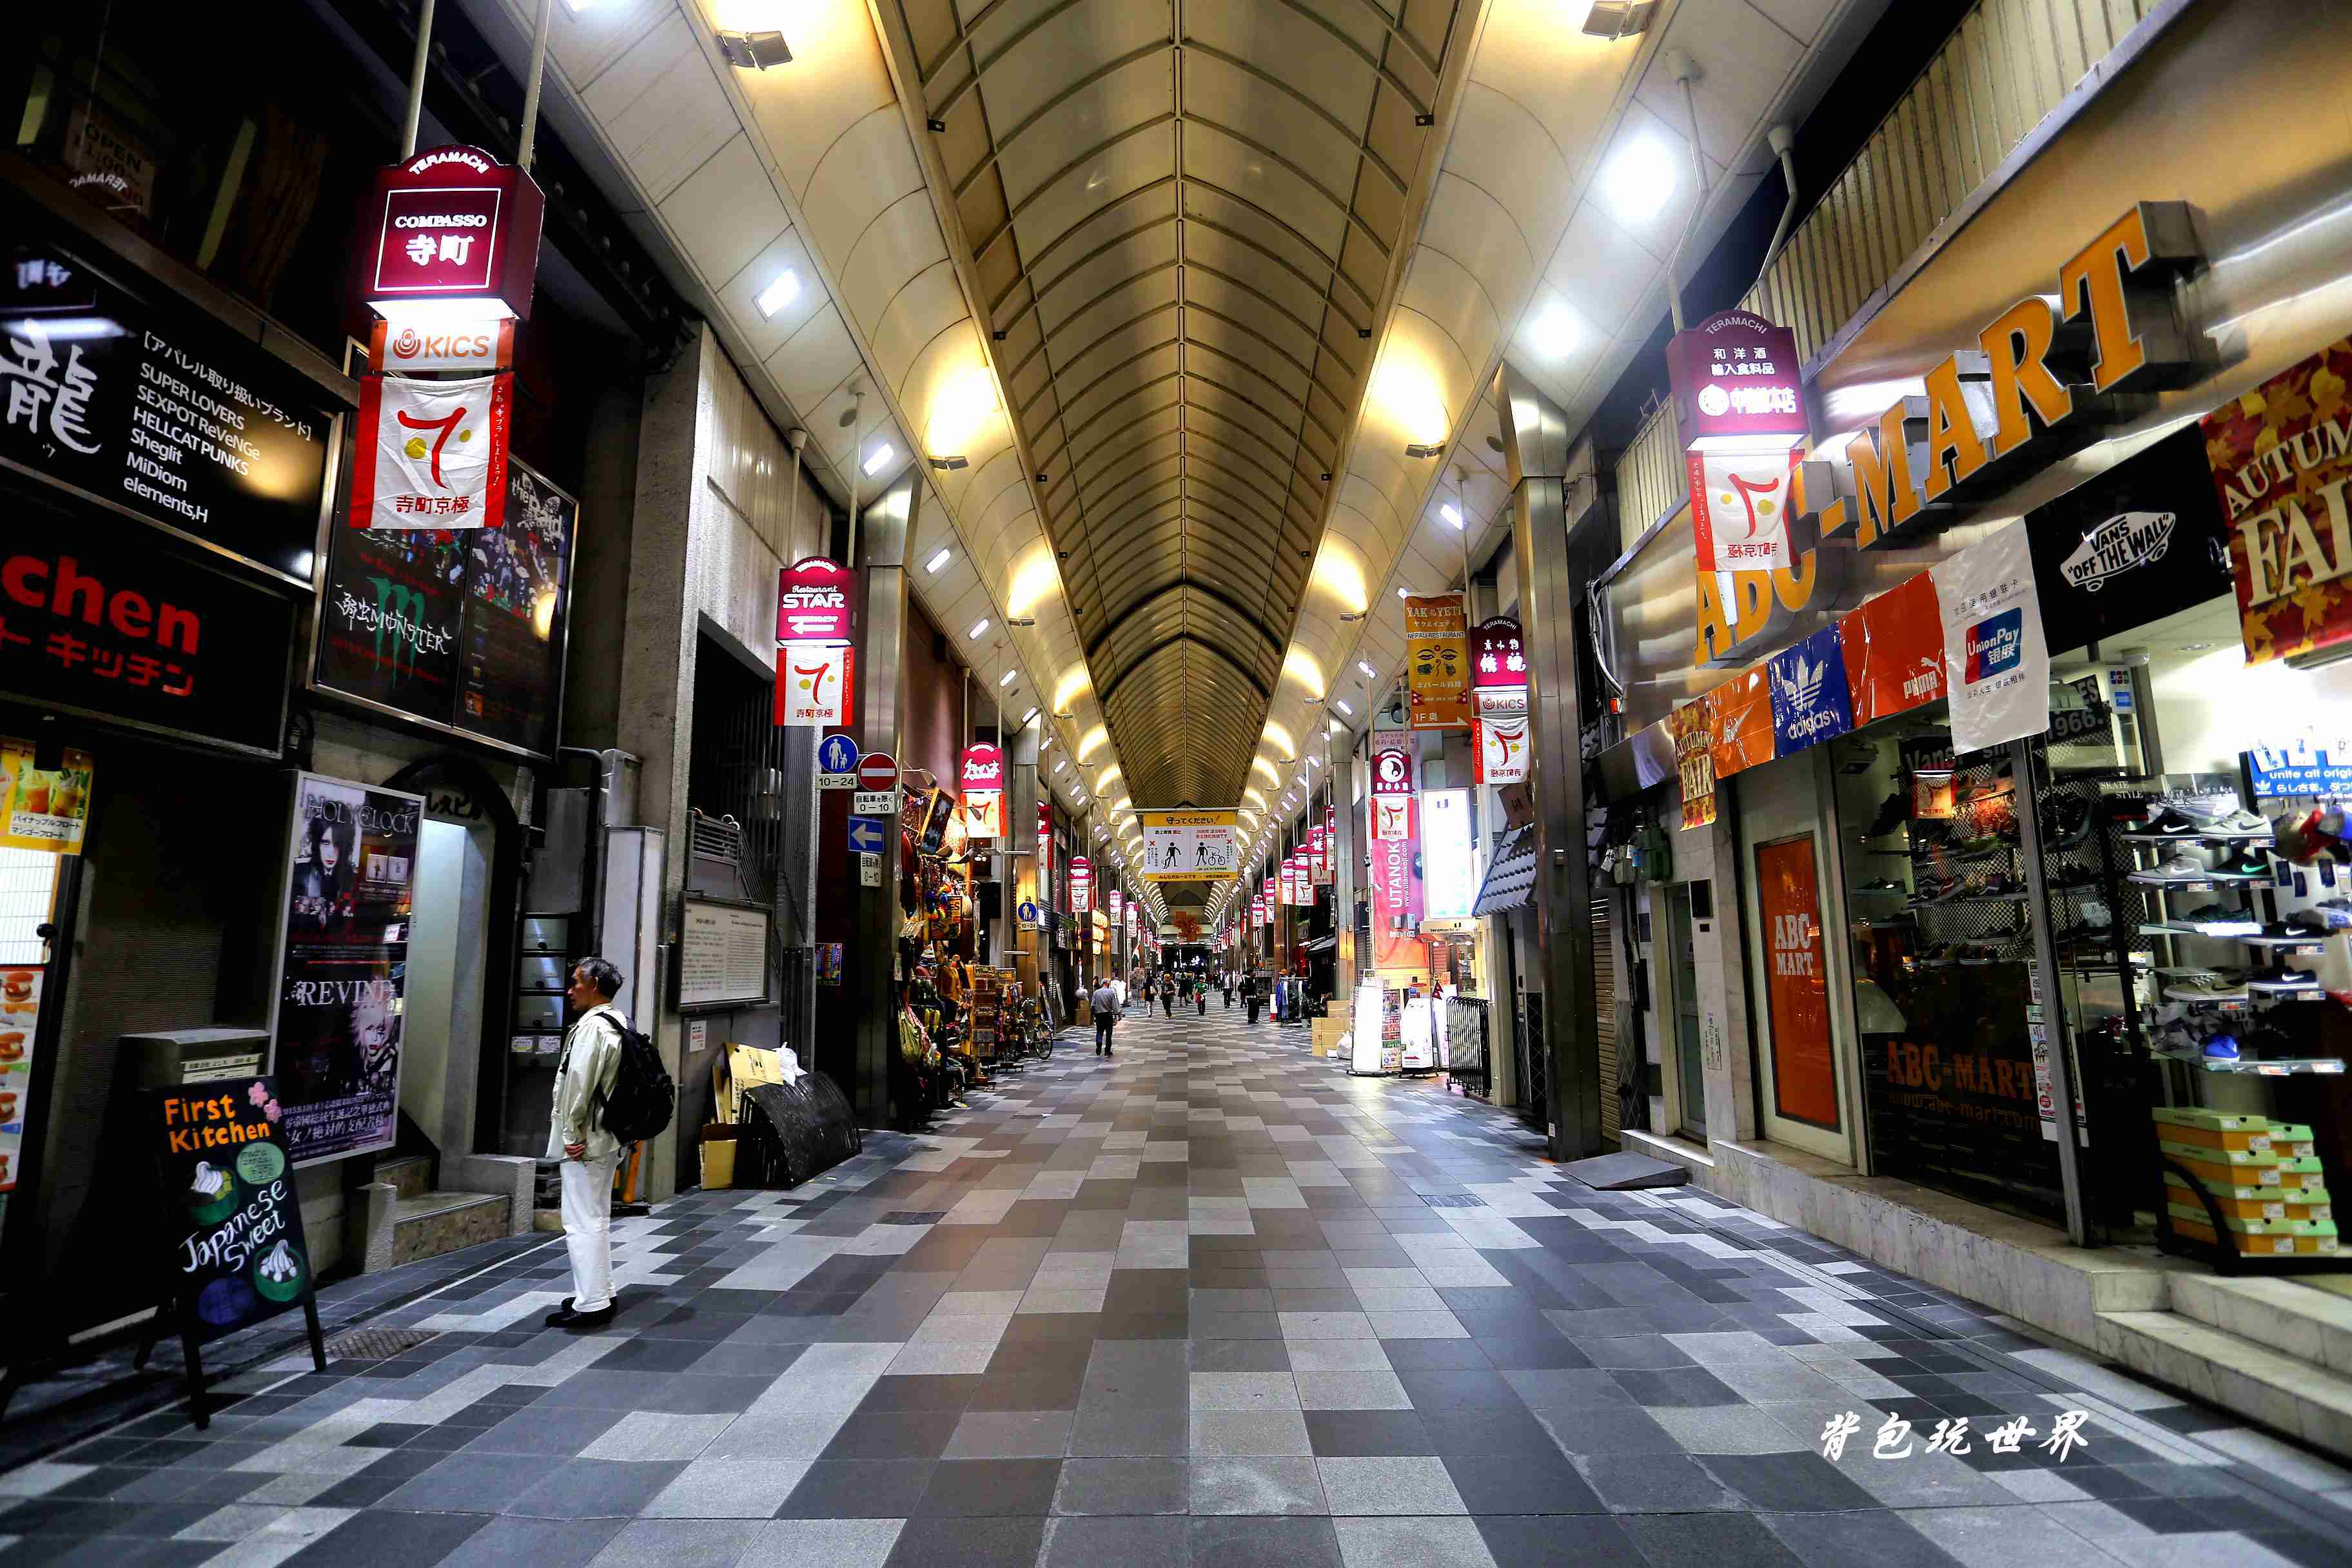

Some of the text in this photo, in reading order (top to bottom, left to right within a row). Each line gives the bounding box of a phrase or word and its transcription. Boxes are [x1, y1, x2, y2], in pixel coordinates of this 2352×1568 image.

[409, 152, 489, 175] TERAMACHI
[395, 215, 487, 228] COMPASSO
[405, 234, 475, 267] 寺町
[1705, 317, 1767, 335] TERAMACHI
[424, 335, 490, 359] KICS
[1713, 347, 1767, 360] 和洋酒
[1710, 362, 1774, 376] 輸入食料品
[140, 362, 246, 431] SUPER LOVERS
[137, 384, 260, 462] SEXPOT ReVeNGe
[130, 427, 183, 465] Sheglit
[133, 406, 250, 476] HELLCAT PUNKS
[126, 451, 188, 492] MiDiom
[123, 476, 209, 523] elements,H
[396, 495, 470, 515] 寺町京極
[2091, 520, 2130, 553] VANS
[2098, 547, 2130, 574] THE
[1, 554, 201, 654] chen
[782, 593, 846, 609] STAR
[1485, 620, 1517, 630] TERAMACHI
[1967, 627, 2019, 657] UnionPay
[46, 632, 194, 698] キッチン
[1496, 699, 1524, 709] KICS
[1788, 711, 1831, 740] adidas
[819, 778, 854, 786] 10-24
[1681, 752, 1712, 803] FAIR
[2101, 781, 2129, 790] SKATE
[2269, 769, 2300, 779] unite
[2304, 768, 2320, 778] all
[1774, 913, 1812, 950] ABC
[1776, 952, 1813, 976] MART
[1887, 1041, 2035, 1100] ABC-MART
[164, 1093, 237, 1126] First
[169, 1121, 271, 1155] Kitchen
[179, 1179, 287, 1273] Japanese
[223, 1210, 286, 1273] Sweet
